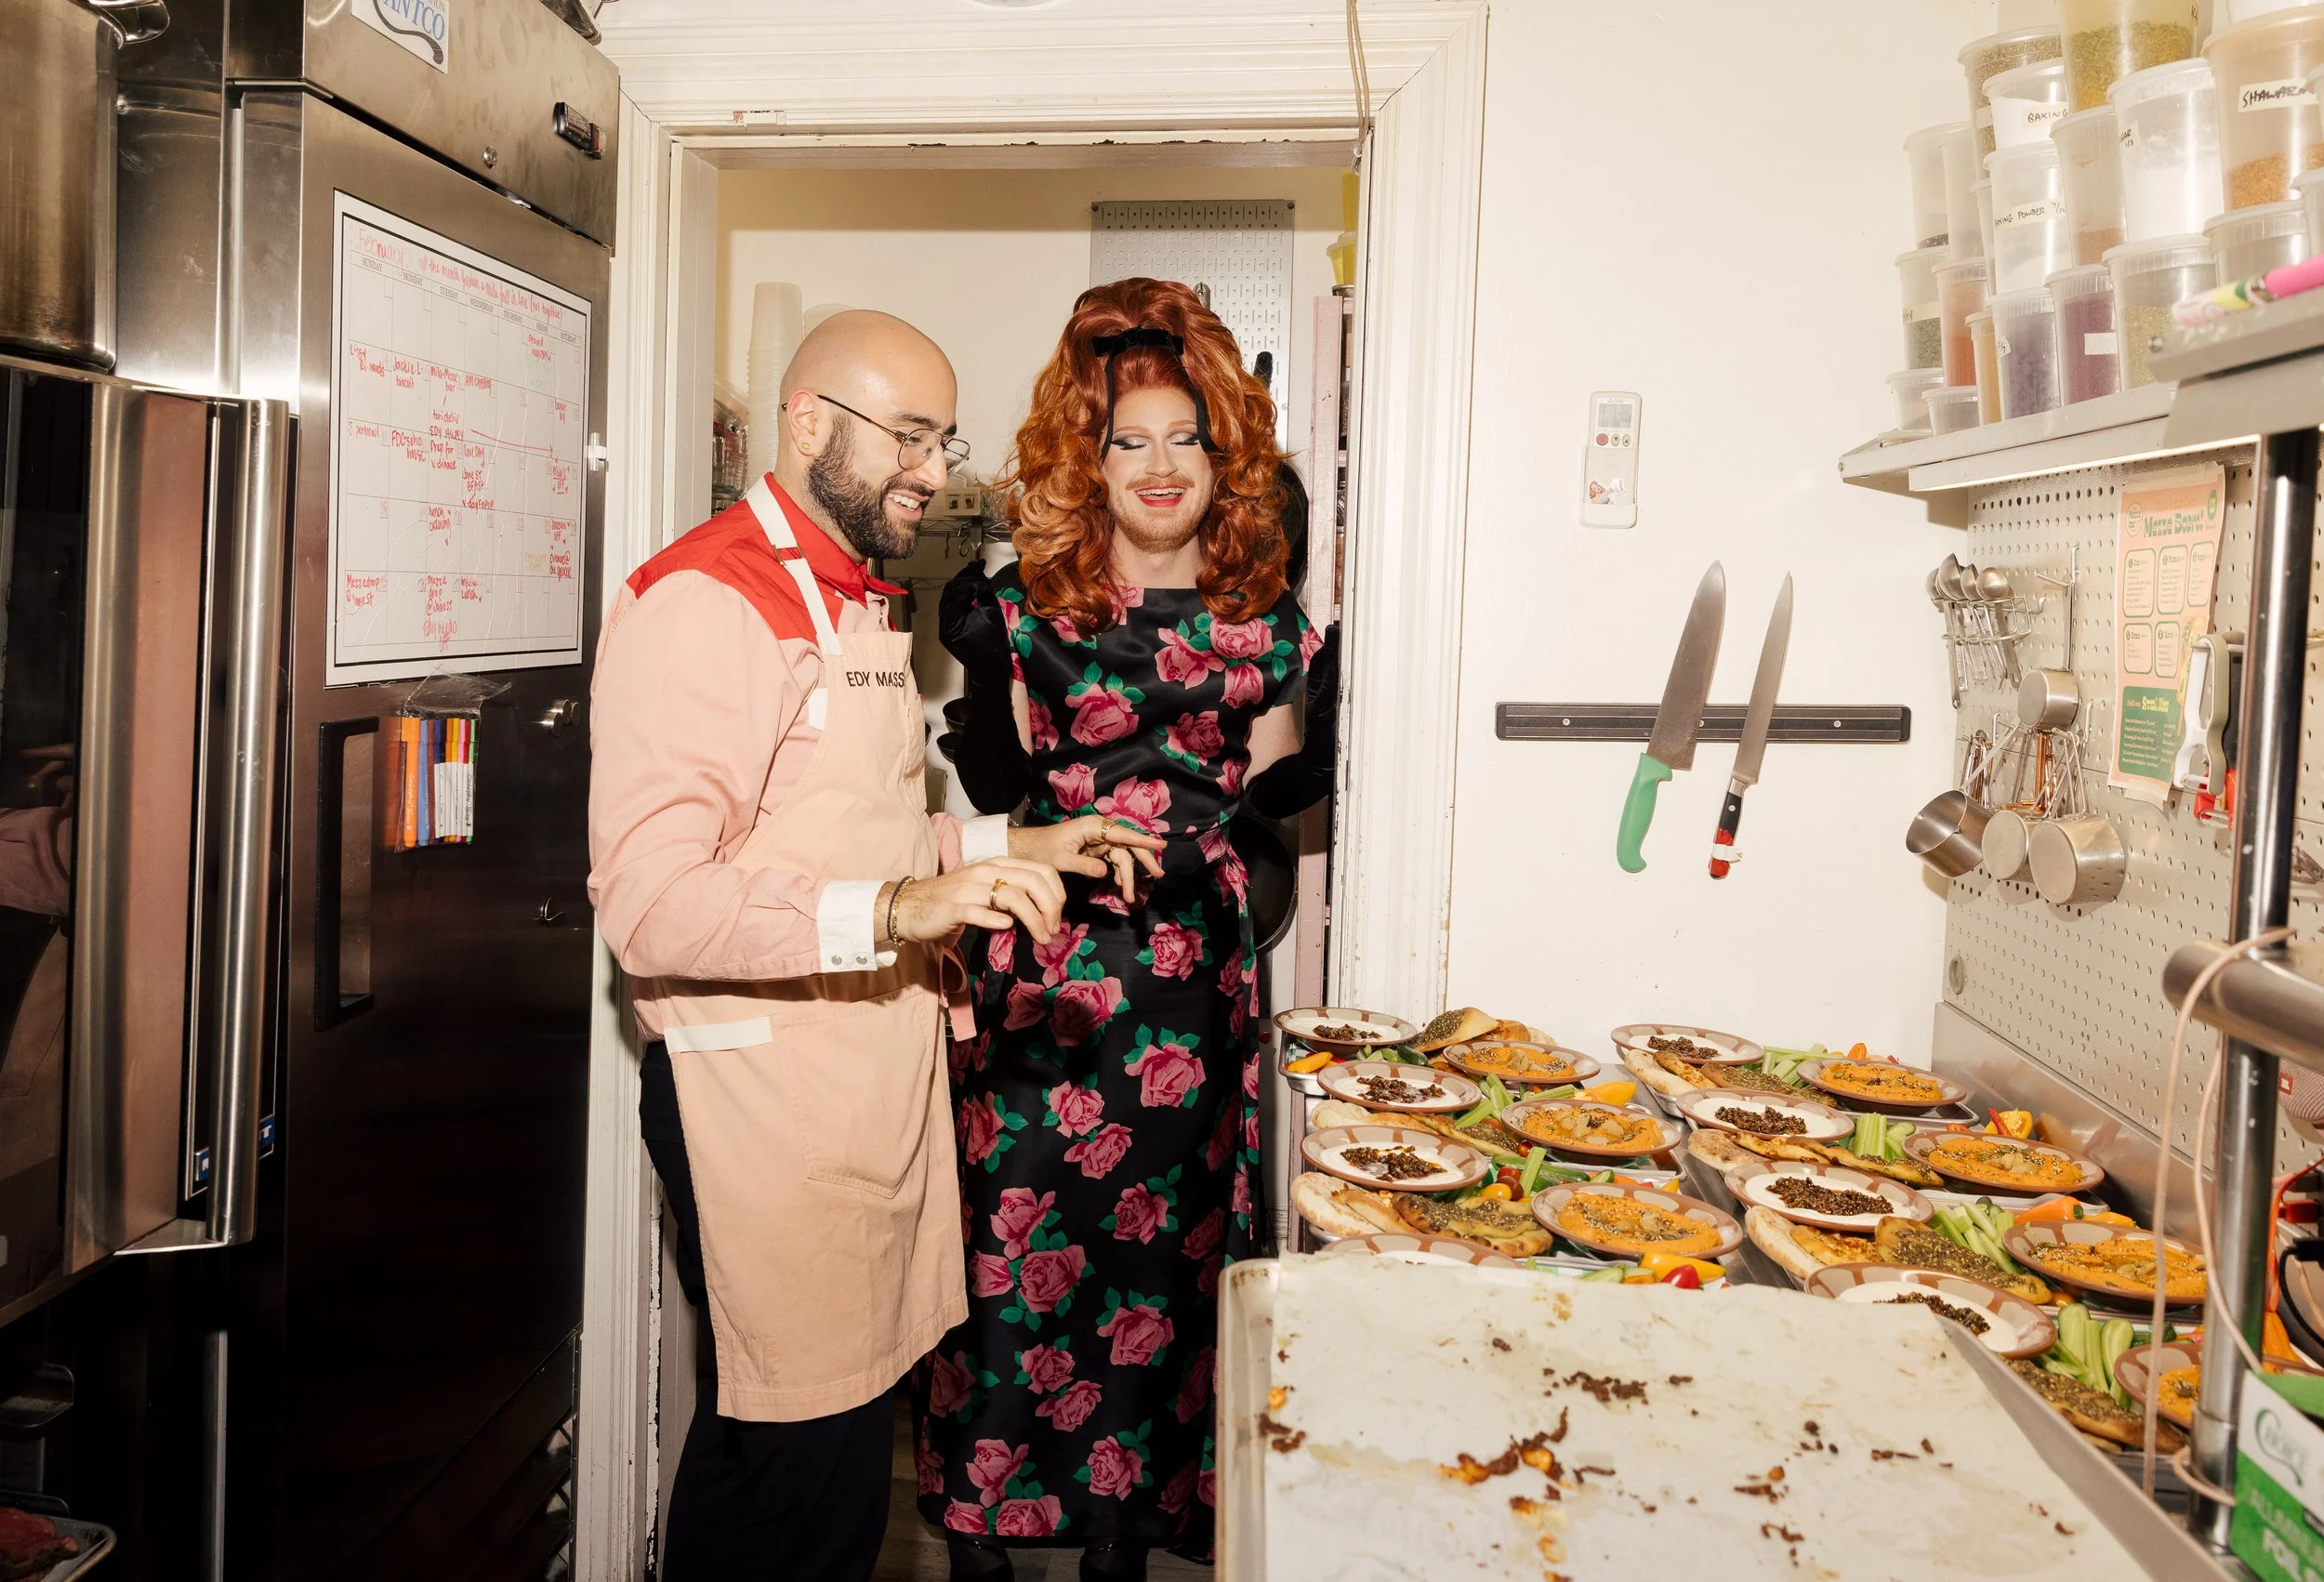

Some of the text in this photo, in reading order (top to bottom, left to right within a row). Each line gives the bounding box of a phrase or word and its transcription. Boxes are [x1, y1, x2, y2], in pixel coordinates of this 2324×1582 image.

[2027, 109, 2069, 124] BAKING
[2017, 206, 2045, 220] POWDER
[358, 226, 404, 270] February
[363, 257, 383, 271] SUNDAY
[403, 271, 423, 285] MONDAY
[440, 285, 458, 300] TUESDAY
[470, 297, 494, 312] WEDNESDAY
[503, 310, 522, 323] THURSDAY
[535, 322, 548, 333] FRIDAY
[560, 332, 576, 343] SATURDAY
[2144, 516, 2172, 538] Mezze
[846, 671, 905, 688] EDY MASS
